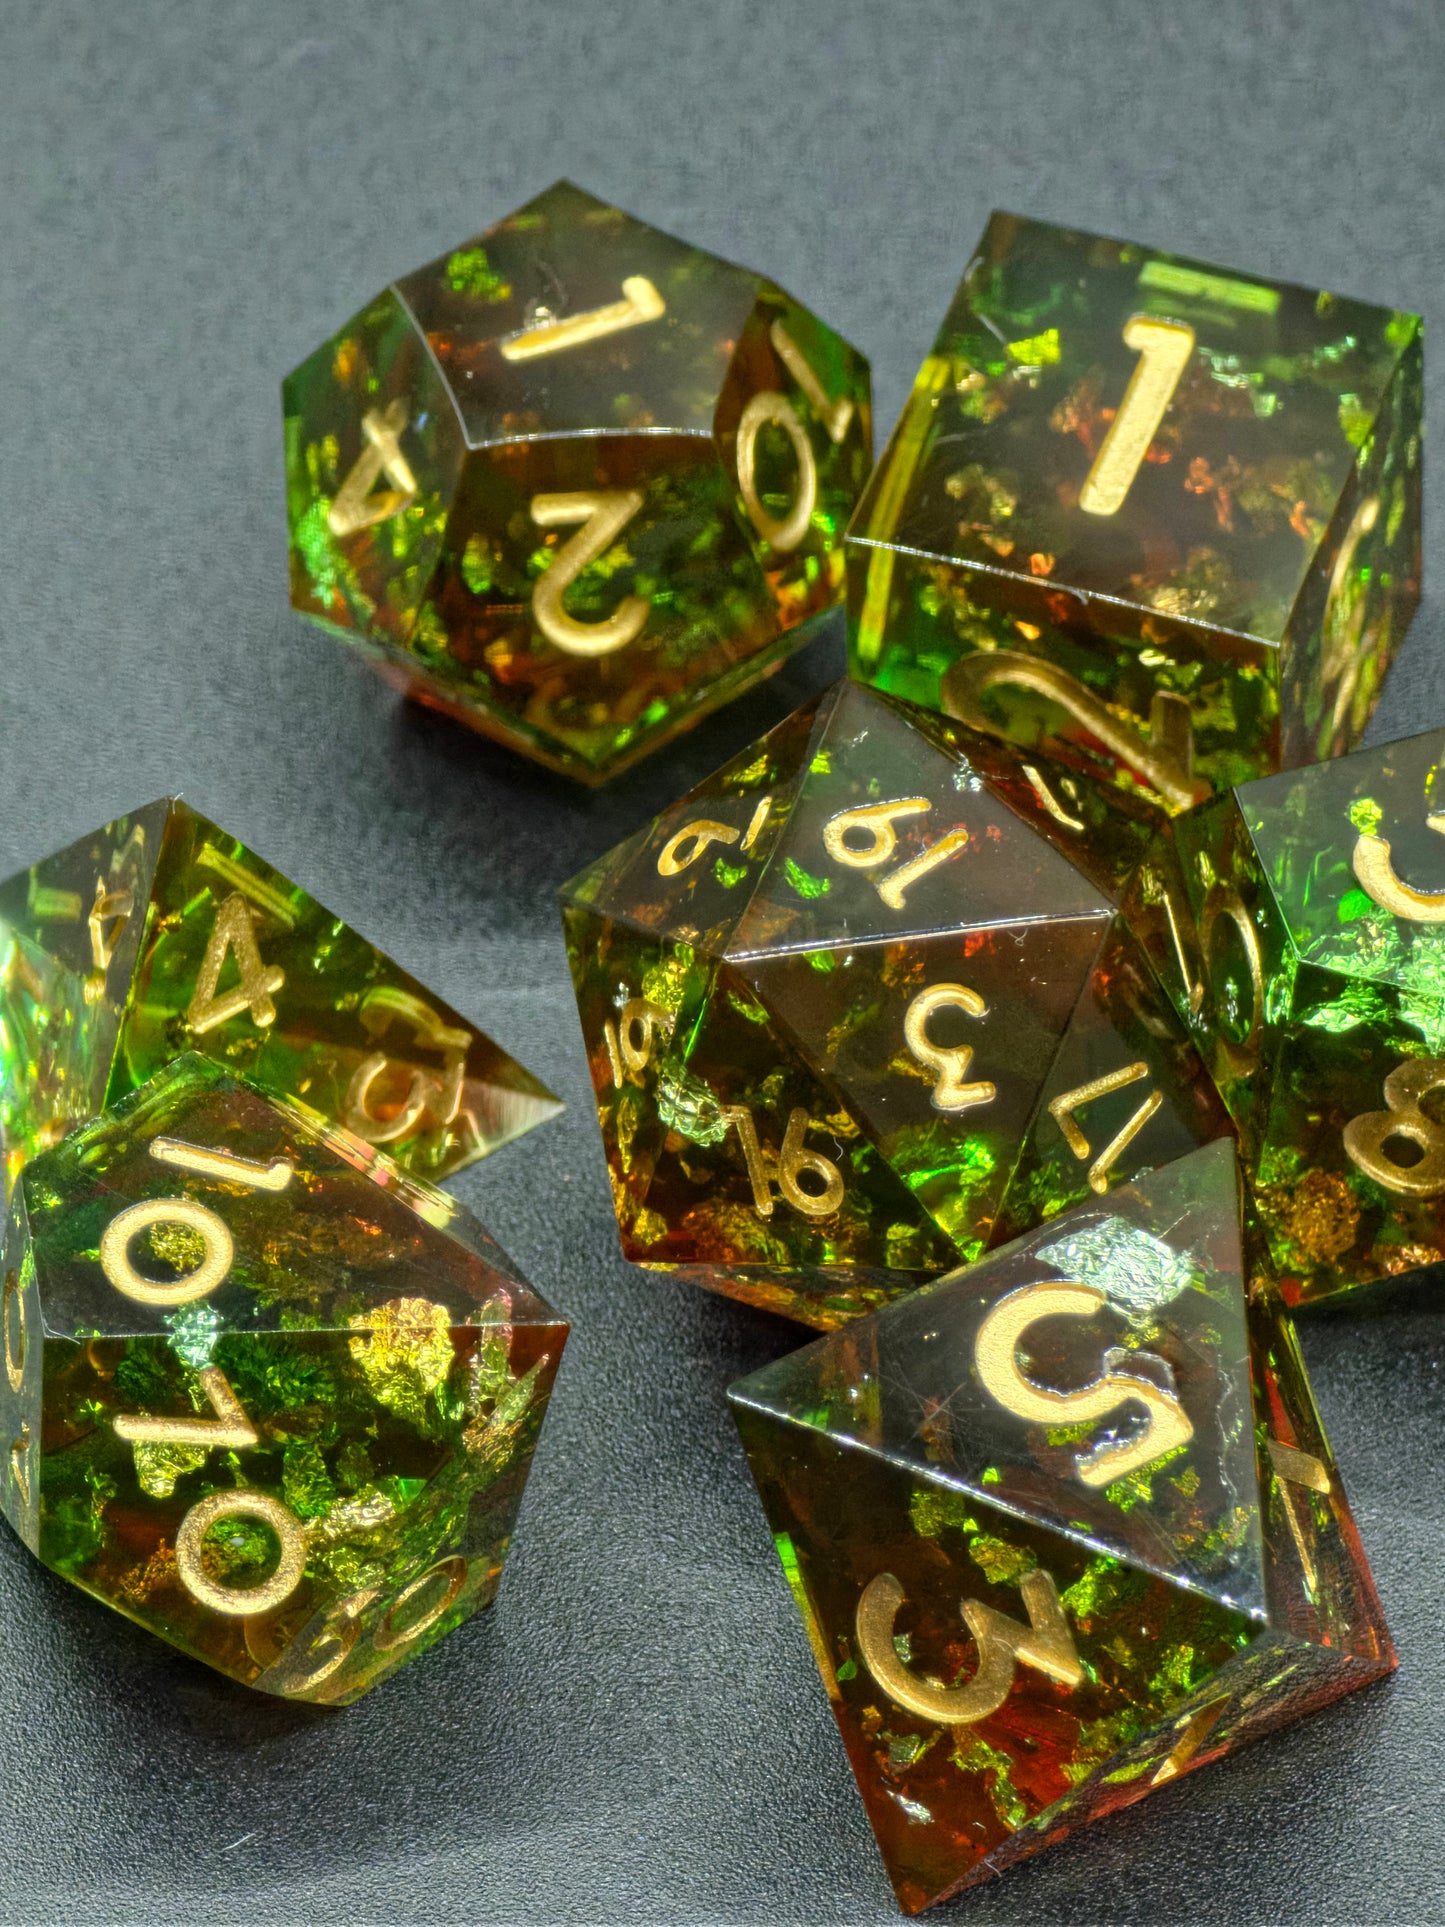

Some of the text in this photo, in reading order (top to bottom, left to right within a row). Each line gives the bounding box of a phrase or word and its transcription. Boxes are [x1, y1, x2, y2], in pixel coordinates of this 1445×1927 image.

[501, 275, 666, 361] 1
[327, 400, 419, 537] 4
[736, 320, 854, 553] 10
[1080, 312, 1195, 515] 1
[531, 490, 651, 657] 2
[186, 892, 286, 1034] 4
[904, 983, 996, 1111] 3
[720, 1104, 845, 1216] 16
[1343, 1058, 1445, 1197] 8
[101, 1135, 294, 1306] 10
[975, 1281, 1193, 1488] 5
[856, 1569, 1082, 1725] 3
